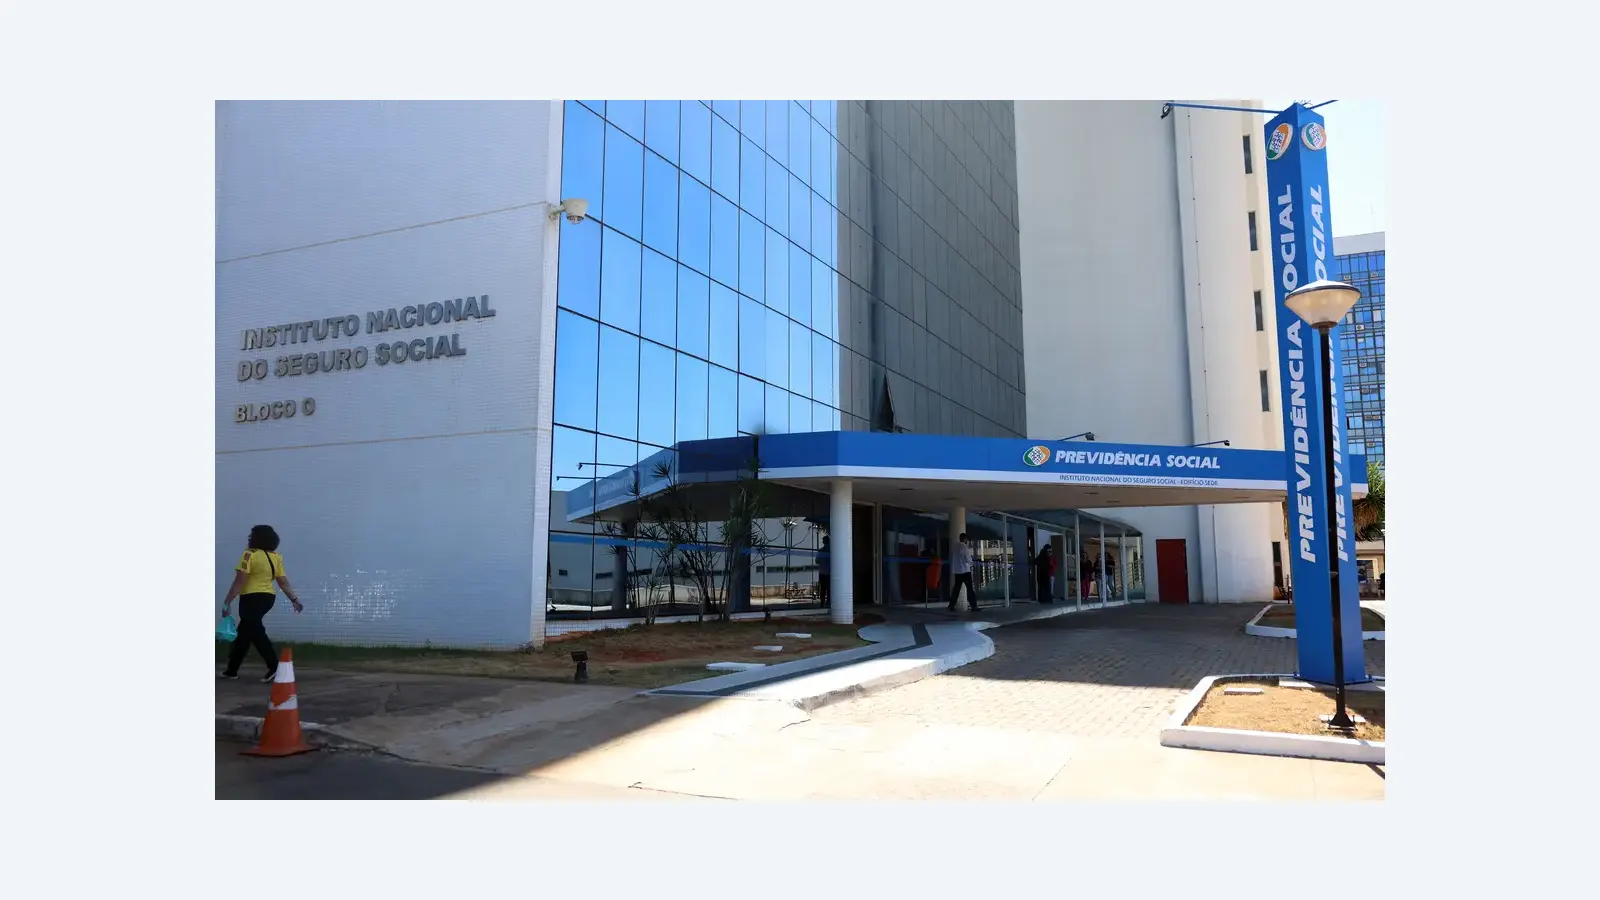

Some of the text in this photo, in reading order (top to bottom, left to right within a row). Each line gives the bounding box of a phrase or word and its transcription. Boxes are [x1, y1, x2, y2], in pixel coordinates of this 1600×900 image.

[1310, 184, 1328, 281] OCIAL
[240, 294, 497, 350] INSTITUTO NACIONAL
[237, 333, 467, 382] DO SEGURO SOCIAL
[1278, 184, 1316, 564] PREVIDÊNCIA OCIAL
[235, 397, 316, 423] BLOCO O
[1055, 450, 1221, 469] PREVIDÊNCIA SOCIAL
[1059, 474, 1090, 482] INSTITUTO
[1091, 475, 1122, 483] NACIONAL
